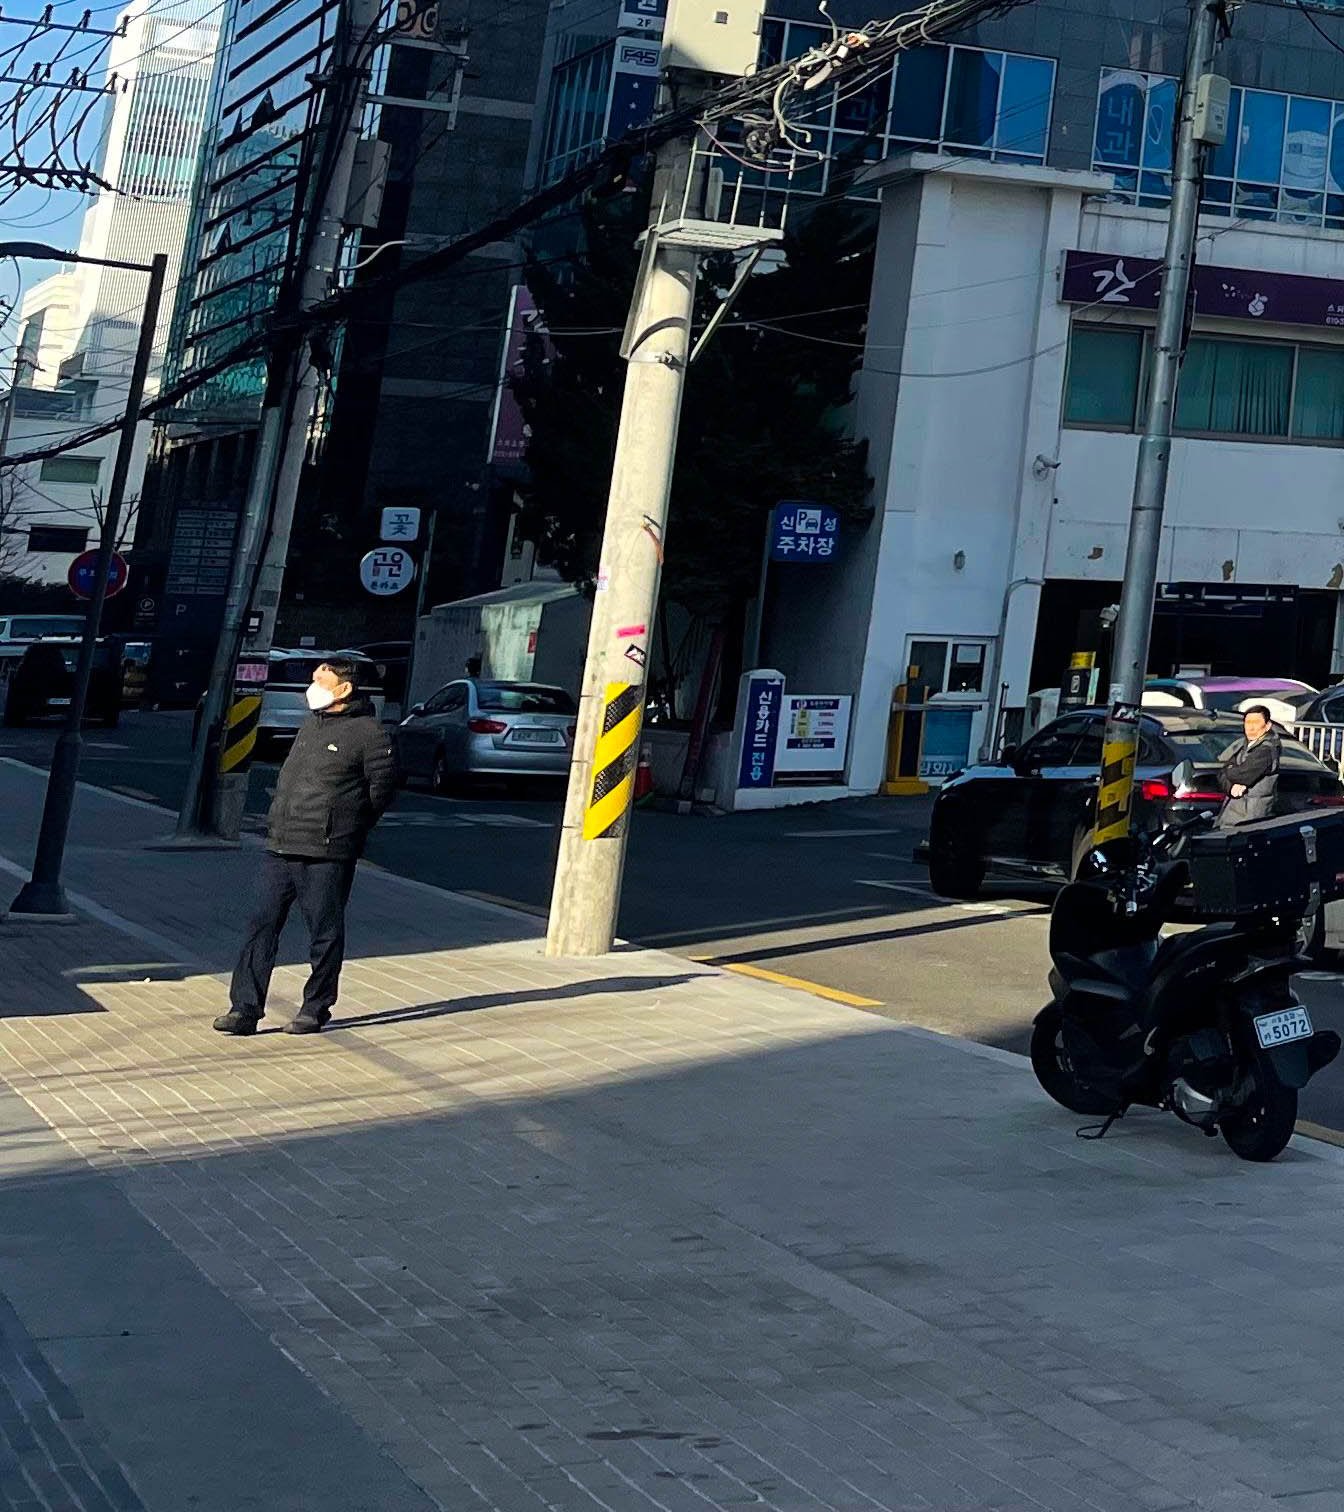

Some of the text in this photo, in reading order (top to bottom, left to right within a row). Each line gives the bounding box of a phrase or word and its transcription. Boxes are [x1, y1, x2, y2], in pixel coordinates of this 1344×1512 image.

[637, 17, 652, 27] 2F
[776, 536, 836, 556] 주차장
[754, 690, 773, 748] 신용카드
[1272, 1019, 1308, 1040] 5072
